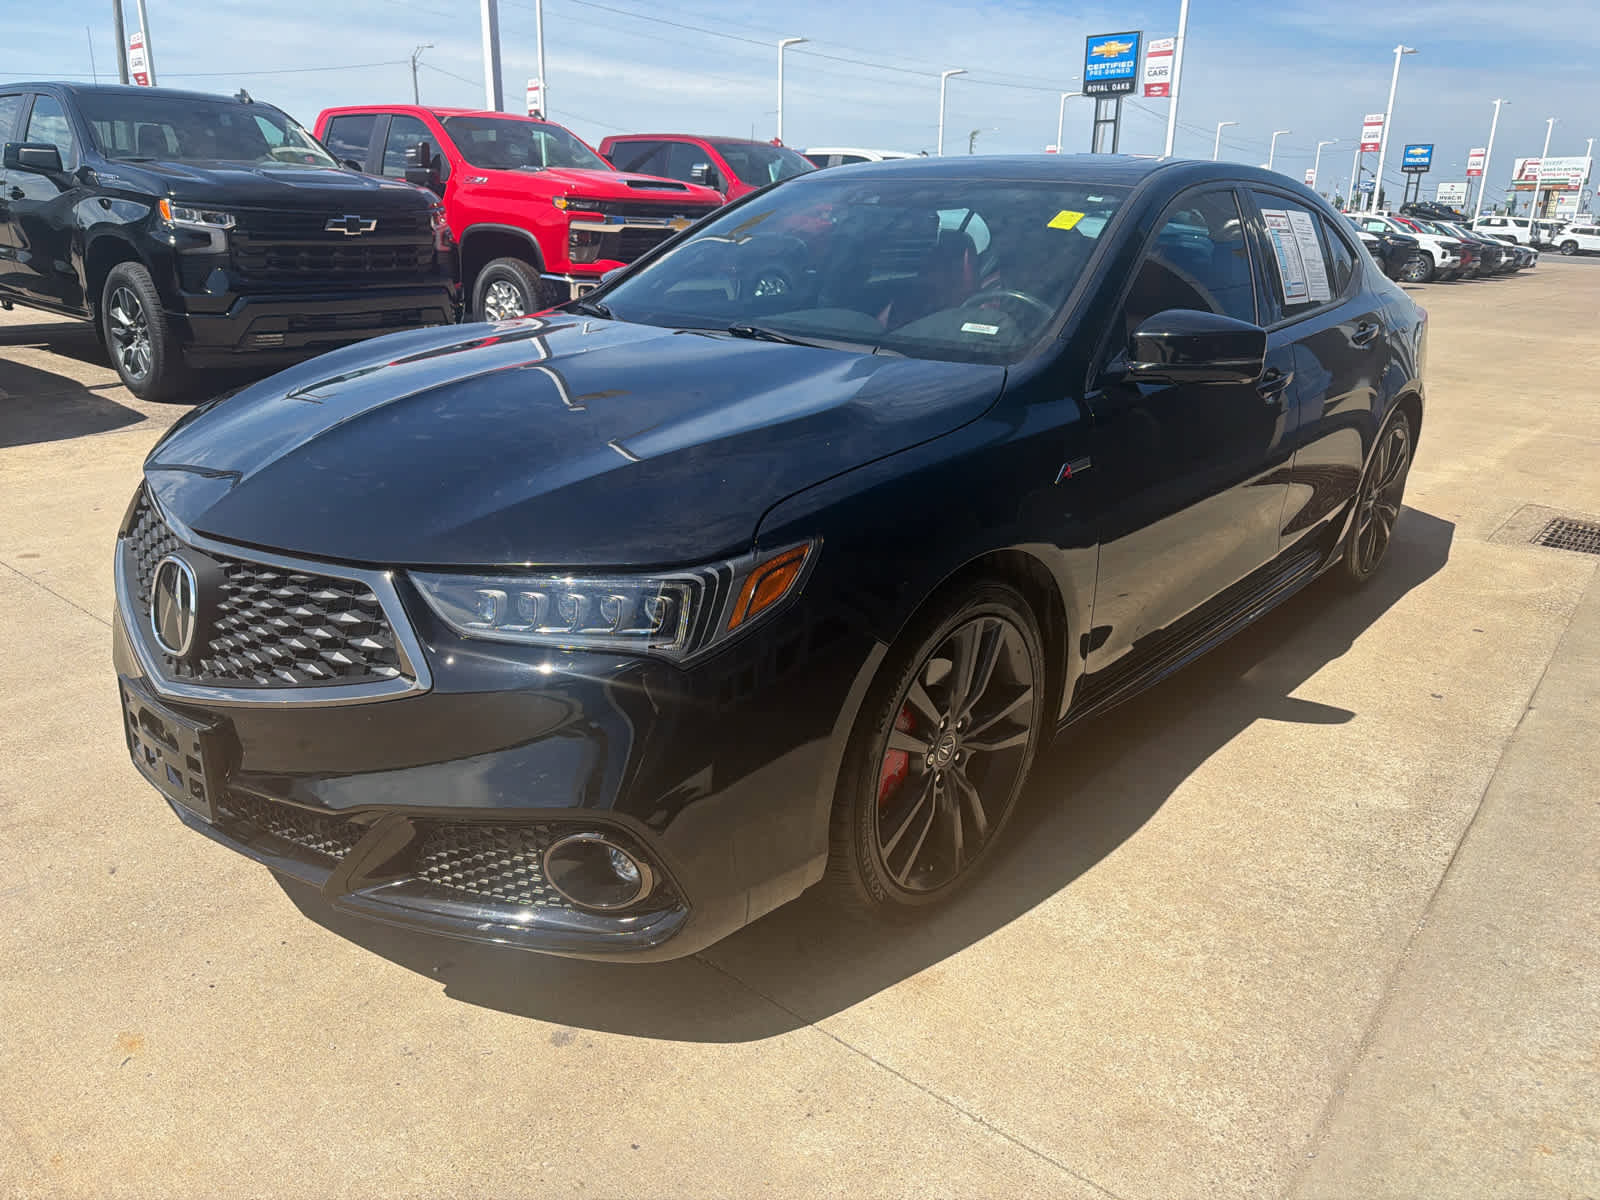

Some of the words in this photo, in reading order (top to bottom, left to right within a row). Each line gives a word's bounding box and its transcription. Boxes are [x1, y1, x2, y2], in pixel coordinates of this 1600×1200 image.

[1087, 61, 1133, 71] CERTIFIED
[1147, 69, 1168, 77] CARS
[1087, 84, 1108, 92] ROYAL
